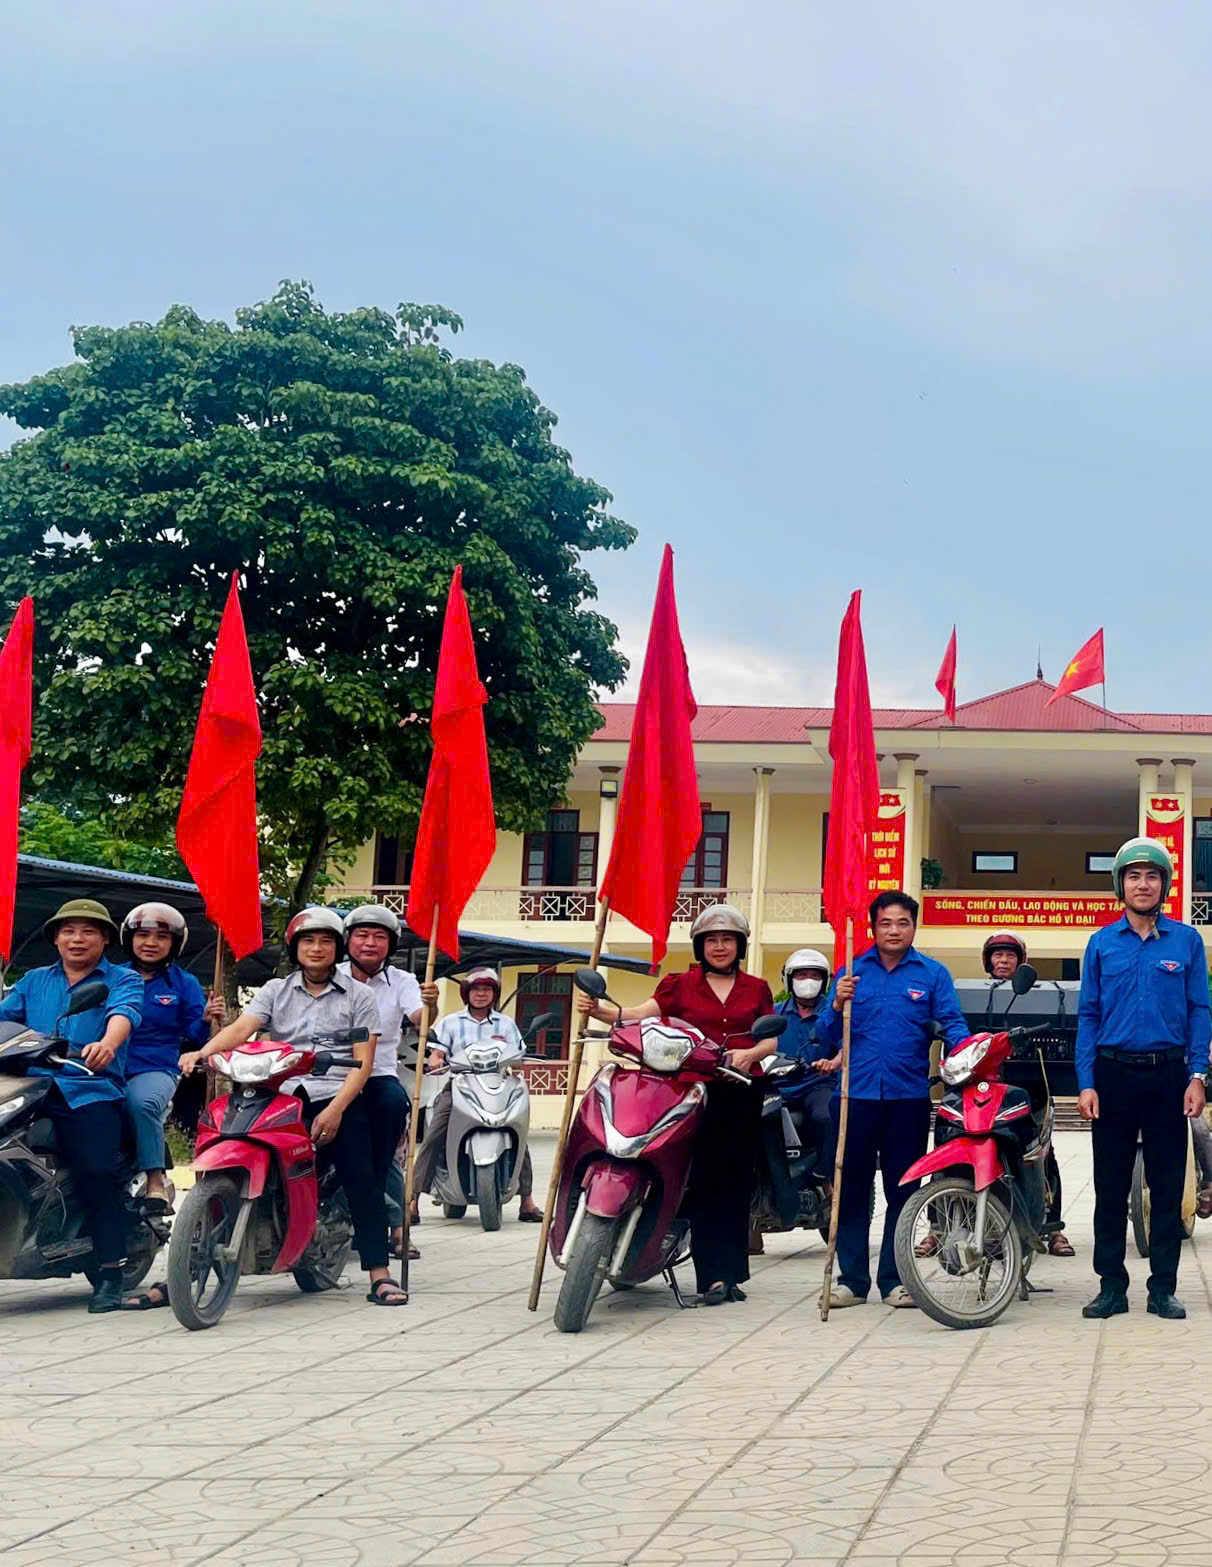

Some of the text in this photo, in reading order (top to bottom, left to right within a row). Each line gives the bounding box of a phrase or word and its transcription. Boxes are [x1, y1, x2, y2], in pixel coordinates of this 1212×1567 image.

[967, 898, 996, 910] CHIẾN
[999, 898, 1021, 911] ĐẤU,
[1023, 901, 1041, 910] LAO
[1043, 900, 1070, 912] ĐỘNG
[1071, 900, 1084, 911] VÀ
[1086, 901, 1106, 912] HỌC
[1108, 901, 1126, 912] TẬP
[966, 914, 990, 923] THEO
[992, 914, 1025, 924] GƯƠNG
[1027, 912, 1046, 924] BÁC
[1075, 915, 1096, 926] ĐẠI!
